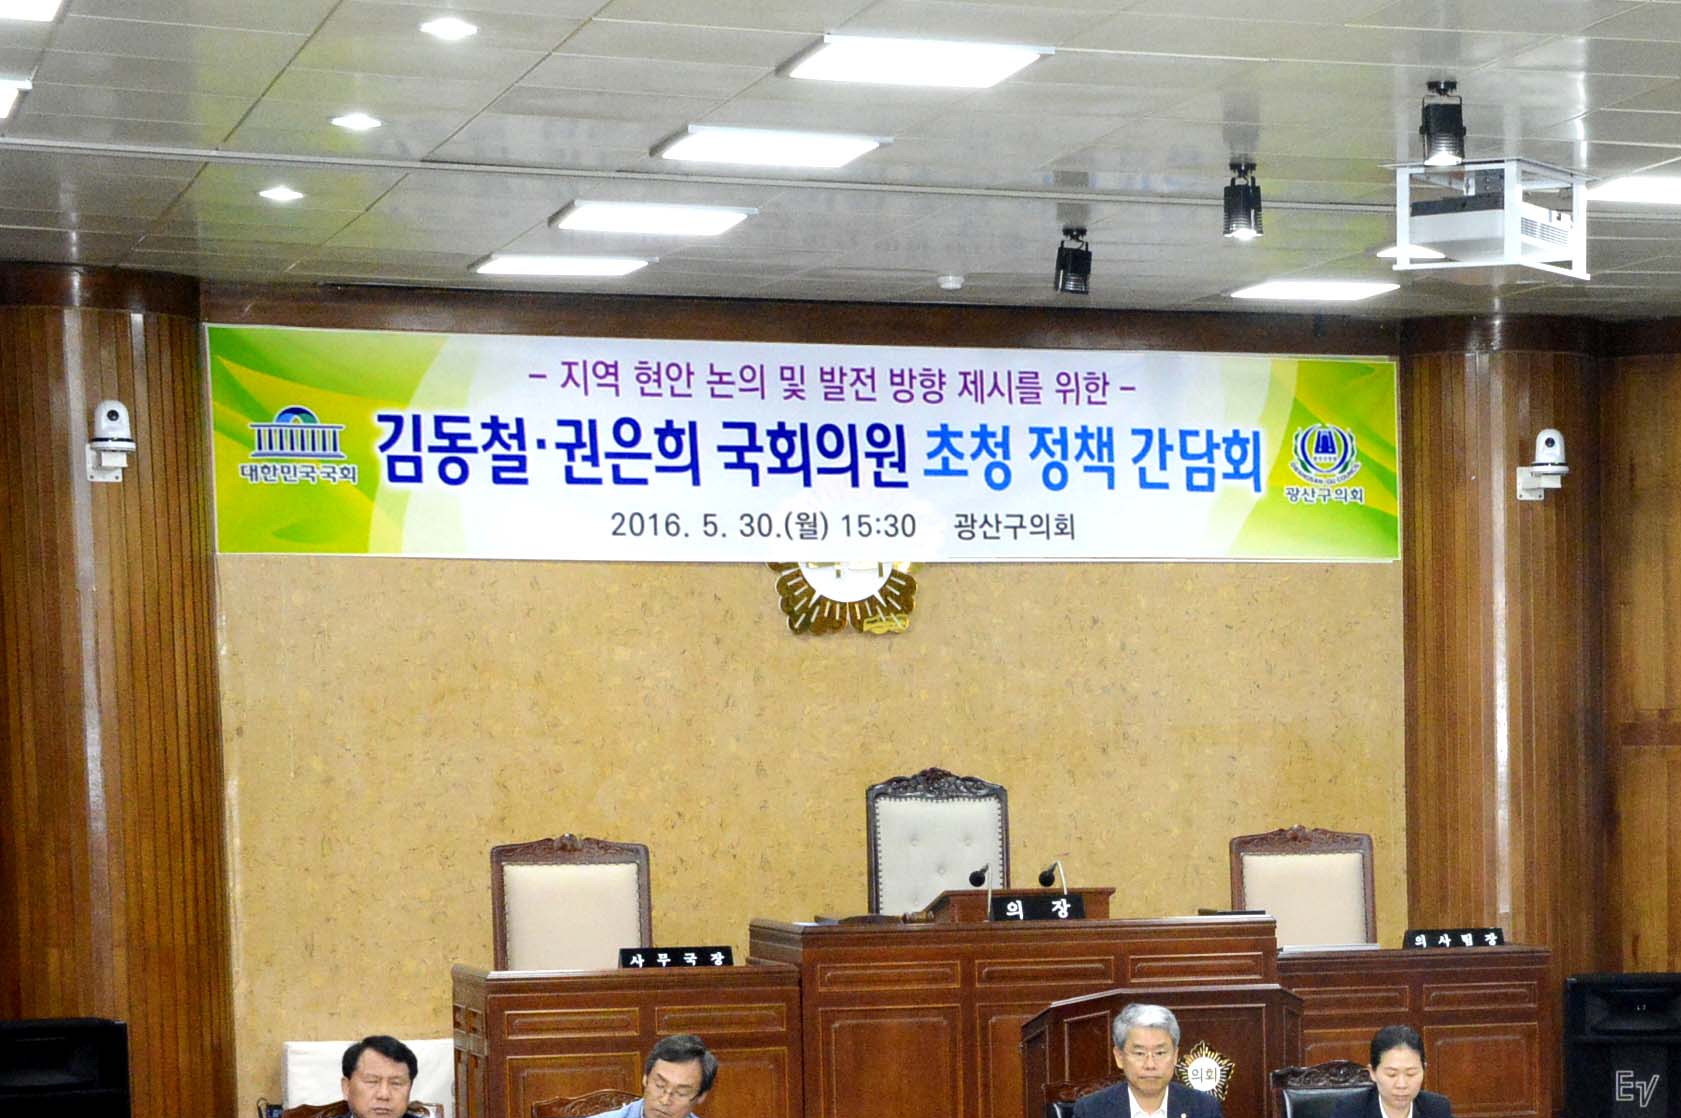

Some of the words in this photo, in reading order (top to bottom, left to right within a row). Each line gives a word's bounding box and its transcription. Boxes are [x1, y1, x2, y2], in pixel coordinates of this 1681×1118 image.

[560, 359, 621, 398] 지역
[634, 359, 695, 399] 현안
[706, 362, 766, 401] 논의
[779, 363, 807, 401] 및
[818, 365, 877, 402] 발전
[889, 367, 947, 405] 방향
[957, 369, 1043, 406] 제시를
[1055, 370, 1110, 407] 위한
[716, 420, 909, 489] 국회의원
[923, 422, 1012, 492] 초청
[1028, 424, 1115, 492] 정책
[1130, 427, 1262, 493] 간담회
[240, 463, 357, 483] 대한민국국회
[1286, 487, 1363, 503] 광산구의회
[611, 512, 689, 538] 2016.
[703, 512, 727, 538] 5.
[739, 511, 828, 540] 30.(월)
[842, 513, 917, 538] 15:30
[954, 513, 1076, 541] 광산구의회
[1006, 898, 1071, 920] 의장
[630, 951, 725, 968] 사무국장
[1191, 1066, 1218, 1083] 의회
